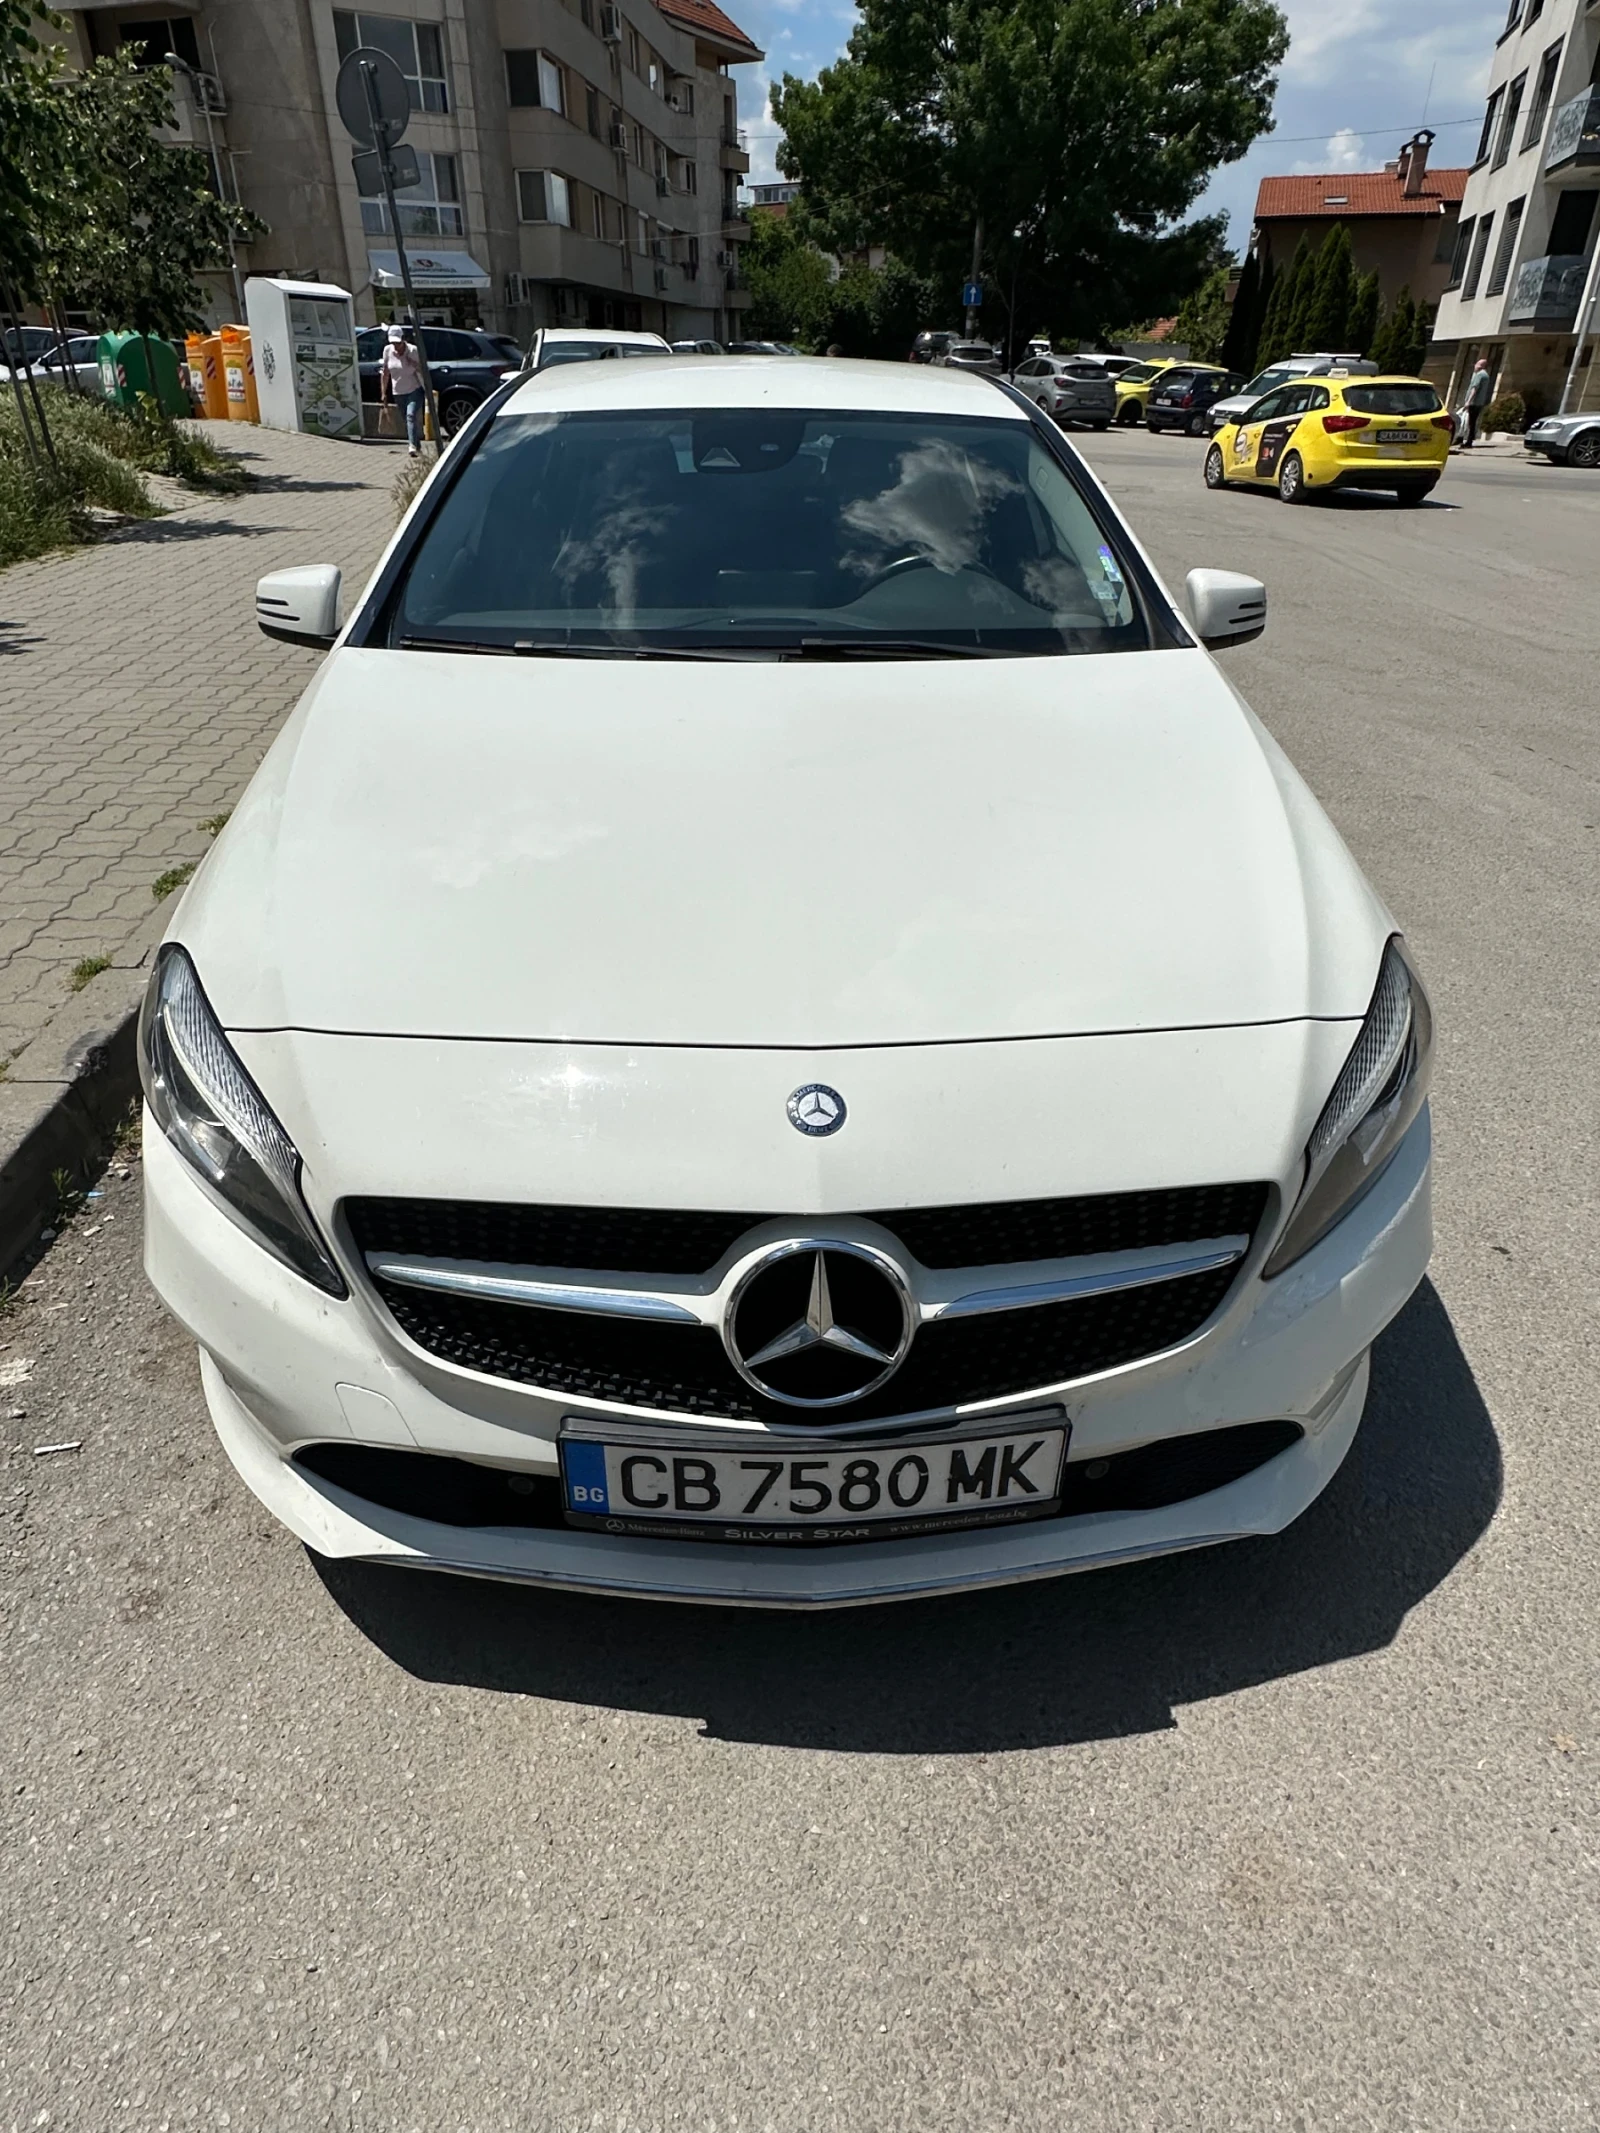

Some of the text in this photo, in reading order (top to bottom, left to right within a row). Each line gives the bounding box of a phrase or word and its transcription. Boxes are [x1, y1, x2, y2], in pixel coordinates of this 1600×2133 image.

[620, 1440, 1045, 1514] CB 7580 MK
[573, 1486, 605, 1503] BG
[724, 1528, 870, 1540] SILVER STAR
